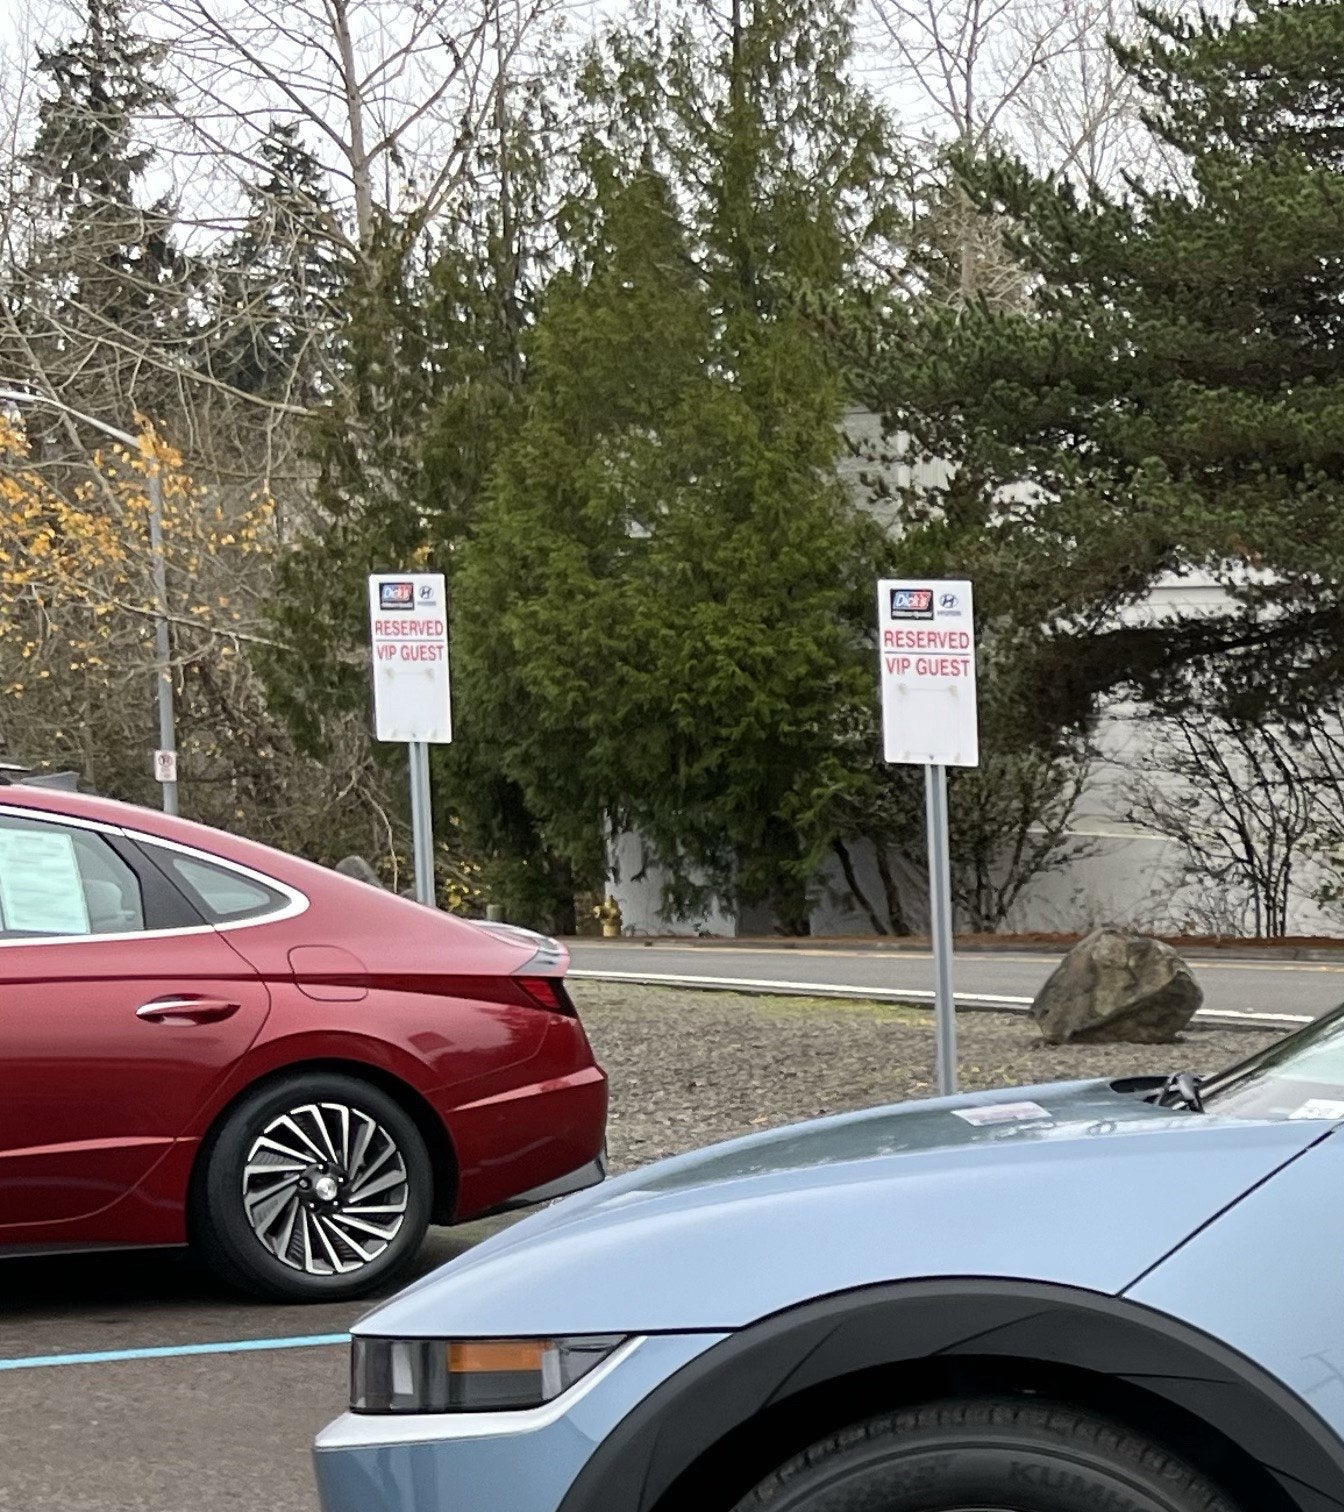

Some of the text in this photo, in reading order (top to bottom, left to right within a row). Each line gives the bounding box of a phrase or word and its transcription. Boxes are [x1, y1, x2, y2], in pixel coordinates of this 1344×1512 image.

[375, 620, 444, 636] RESERVED
[883, 631, 970, 649] RESERVED
[377, 645, 445, 661] VIP GUEST
[885, 658, 970, 677] VIP GUEST
